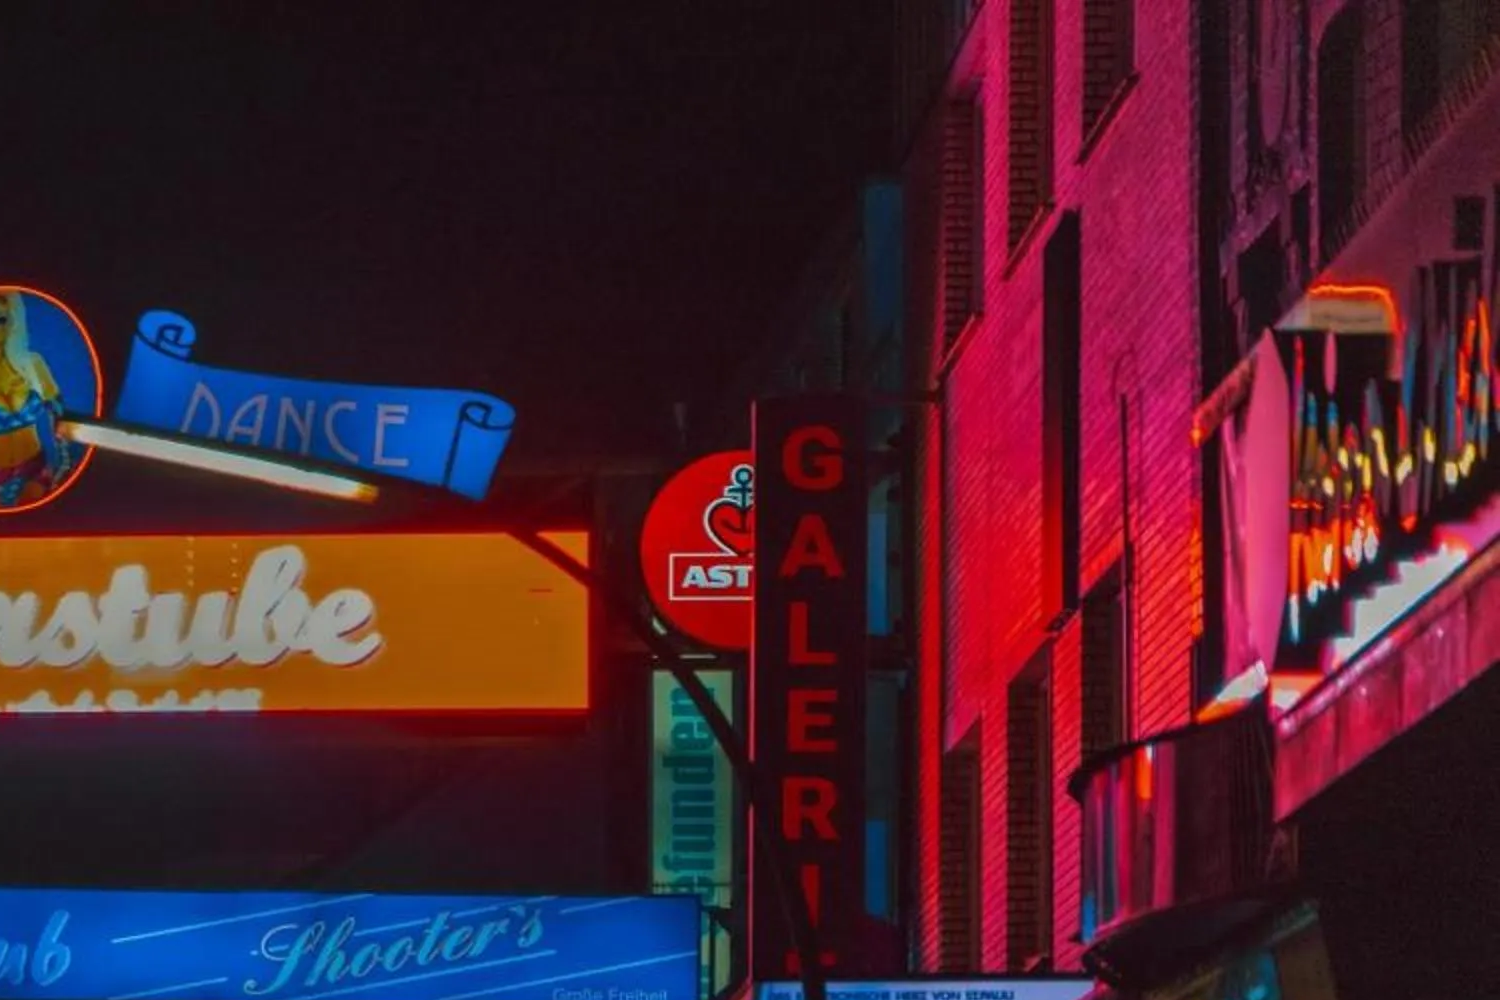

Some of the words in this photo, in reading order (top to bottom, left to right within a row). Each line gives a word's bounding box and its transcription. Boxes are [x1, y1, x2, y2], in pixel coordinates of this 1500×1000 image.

[180, 382, 411, 468] DANCE
[681, 565, 753, 588] AST
[780, 424, 845, 975] GALERI
[244, 903, 544, 995] Shooter's
